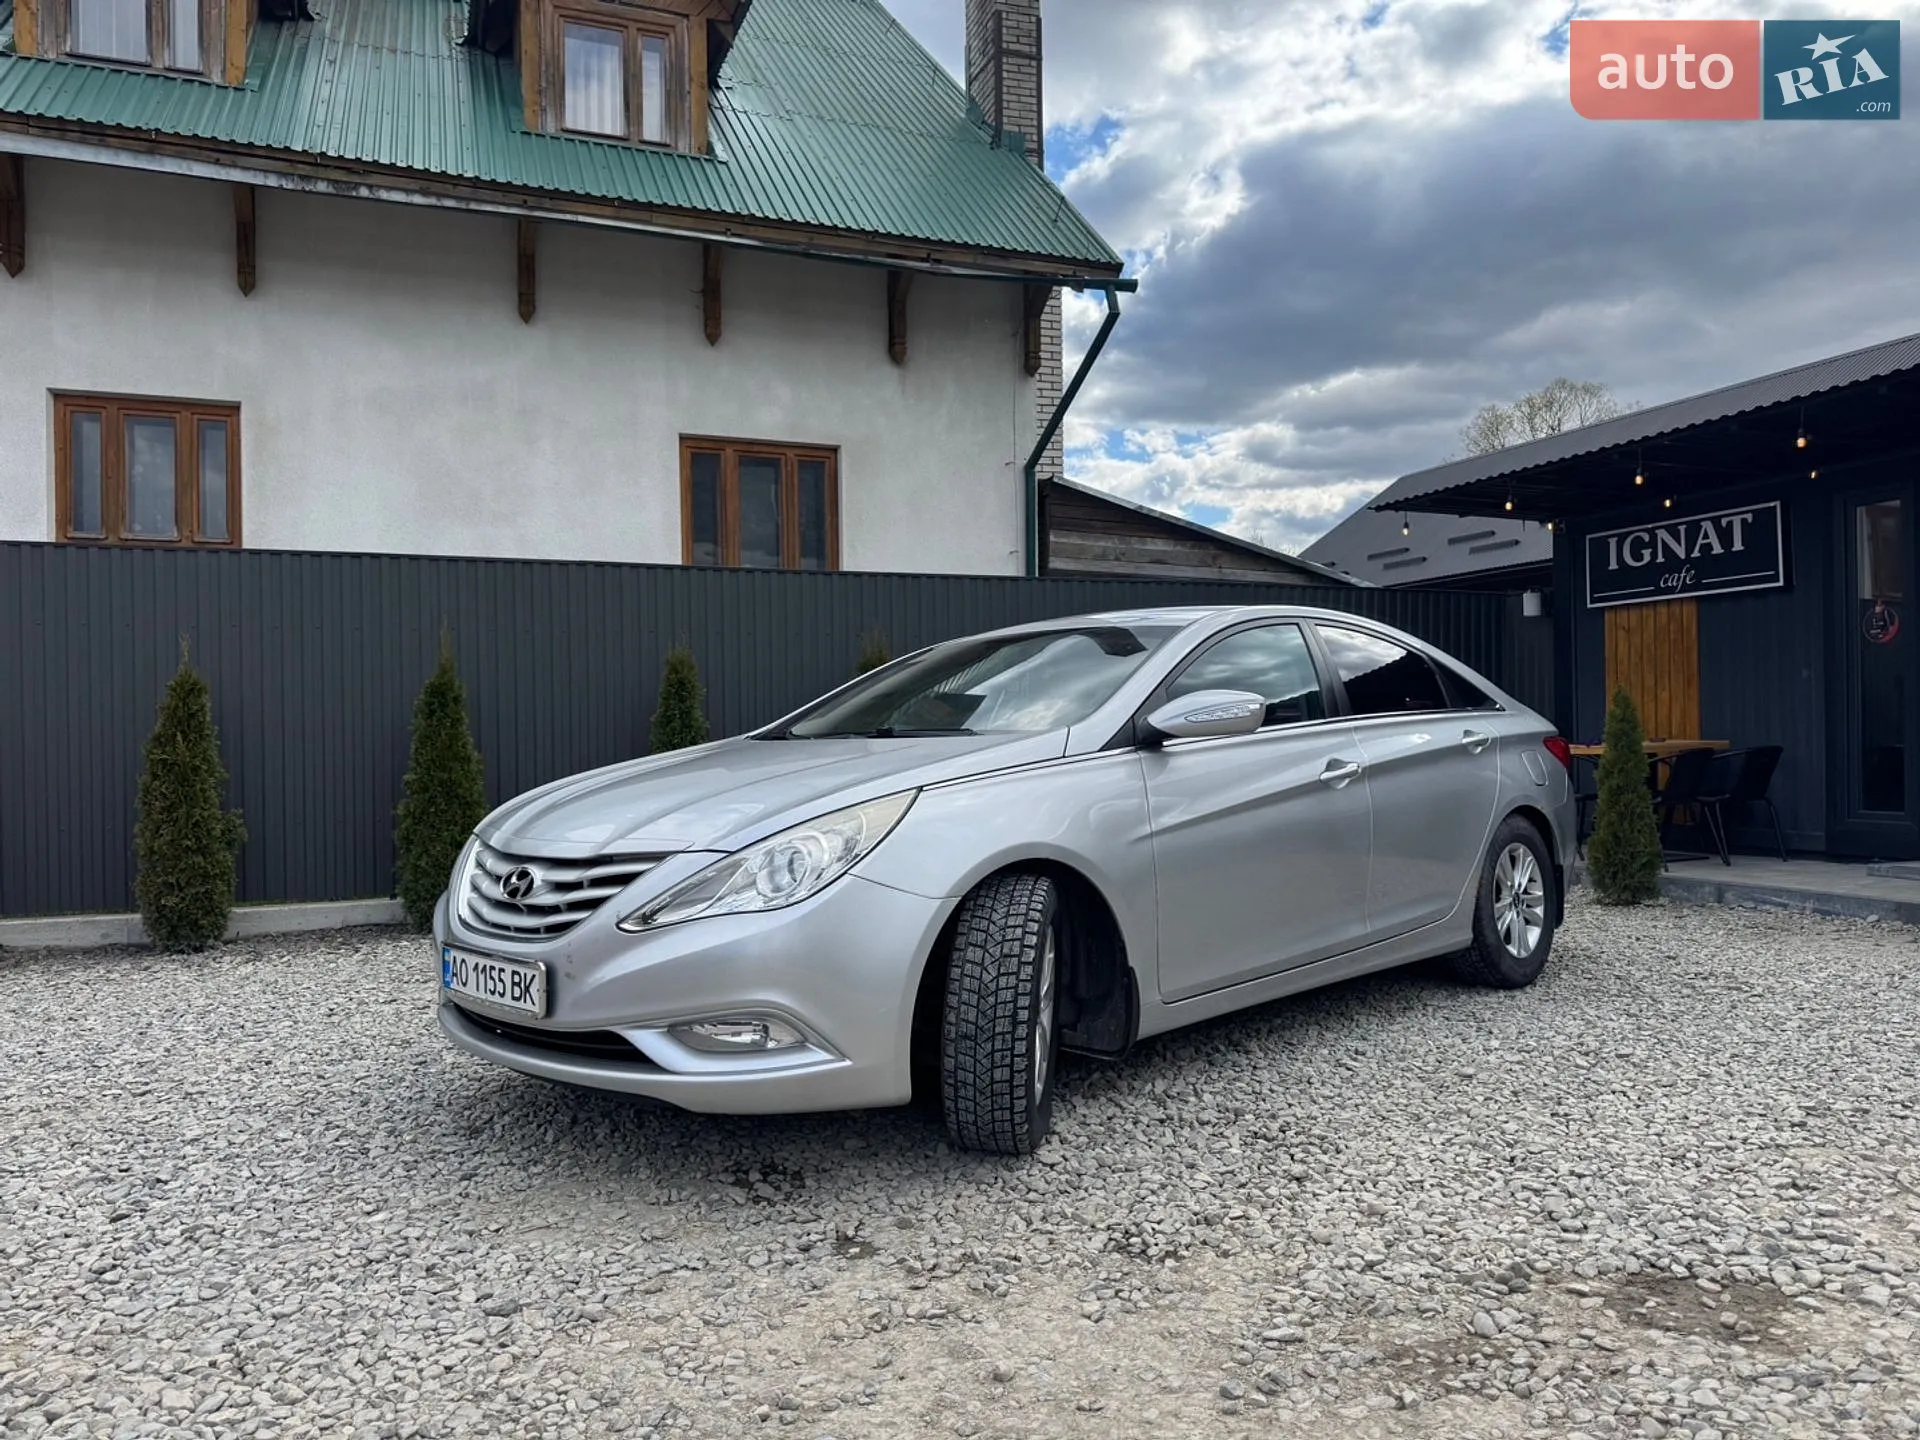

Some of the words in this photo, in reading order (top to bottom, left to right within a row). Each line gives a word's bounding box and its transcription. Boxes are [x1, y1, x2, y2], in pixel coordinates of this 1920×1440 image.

[1607, 513, 1753, 570] IGNAT
[1660, 565, 1695, 593] cafe
[451, 956, 469, 988] AO
[472, 962, 506, 998] 1155
[511, 970, 537, 1006] BK
